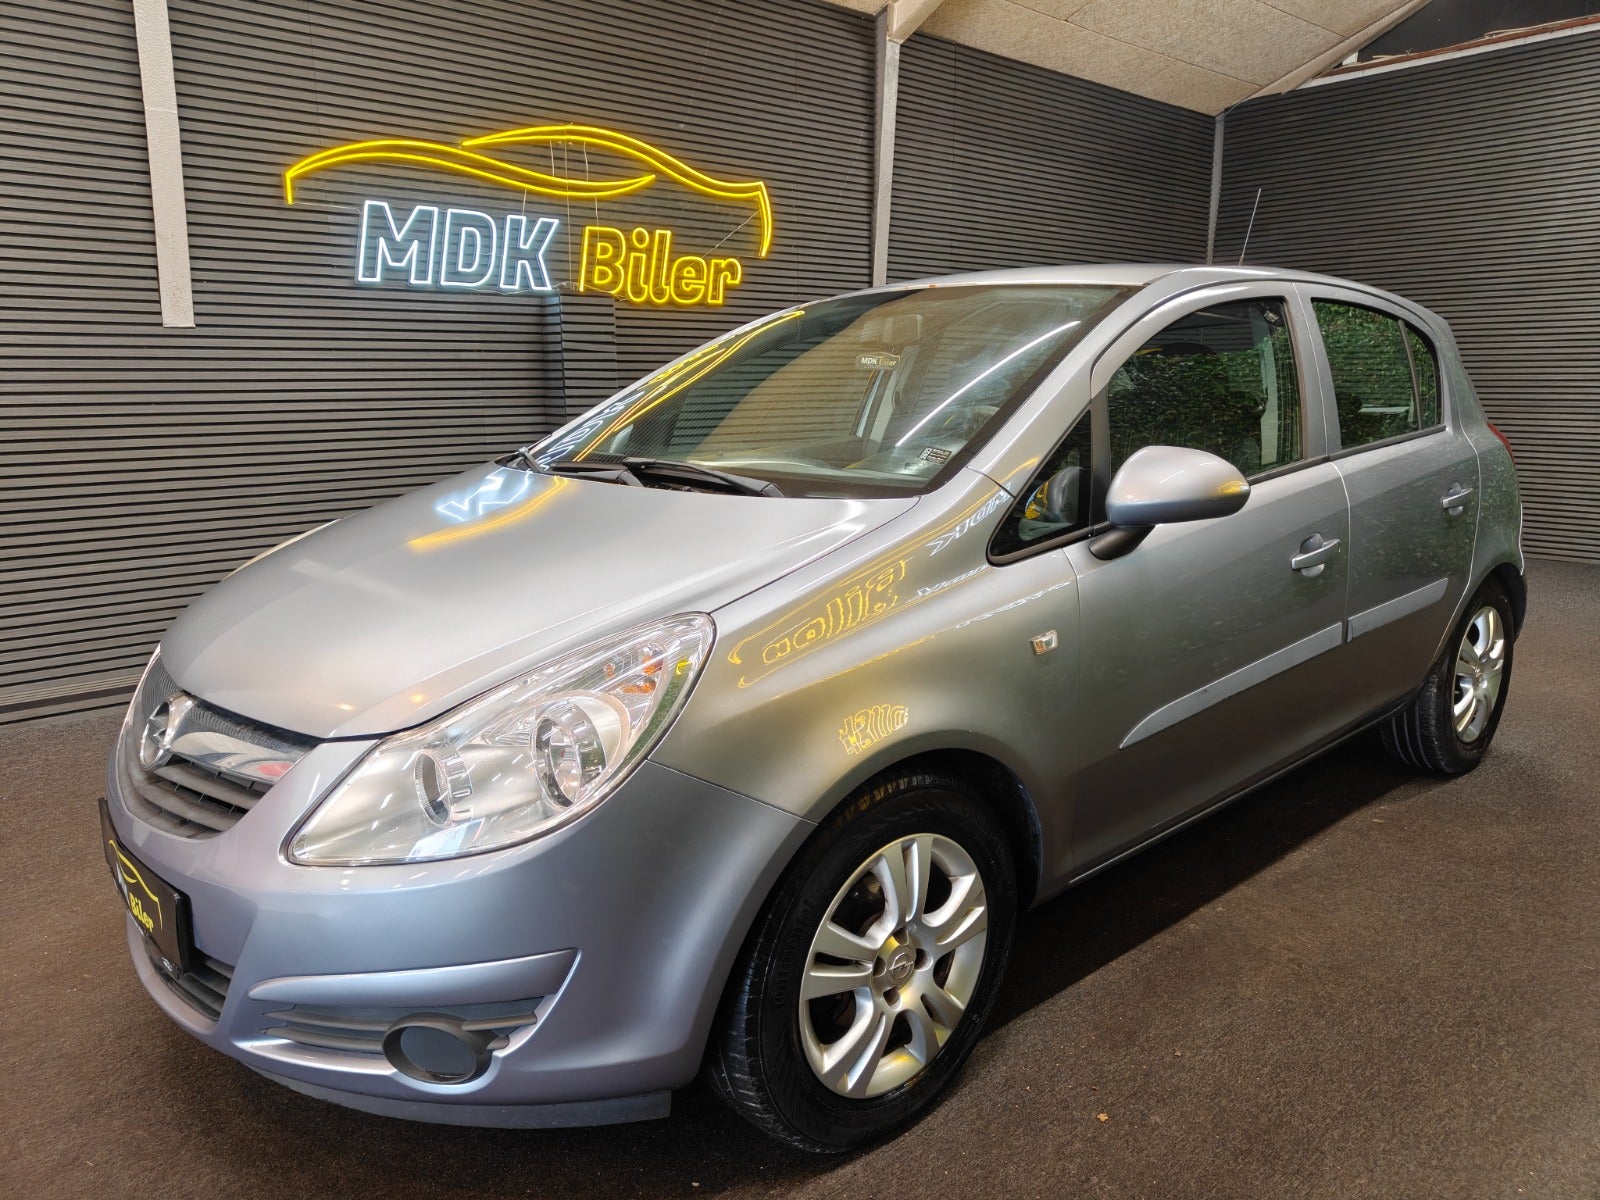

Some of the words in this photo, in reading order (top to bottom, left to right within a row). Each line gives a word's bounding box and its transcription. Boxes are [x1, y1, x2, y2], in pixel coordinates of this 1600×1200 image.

[356, 200, 560, 292] MDK
[578, 225, 742, 305] Biler
[861, 357, 877, 365] MDK
[129, 892, 154, 932] Biler
